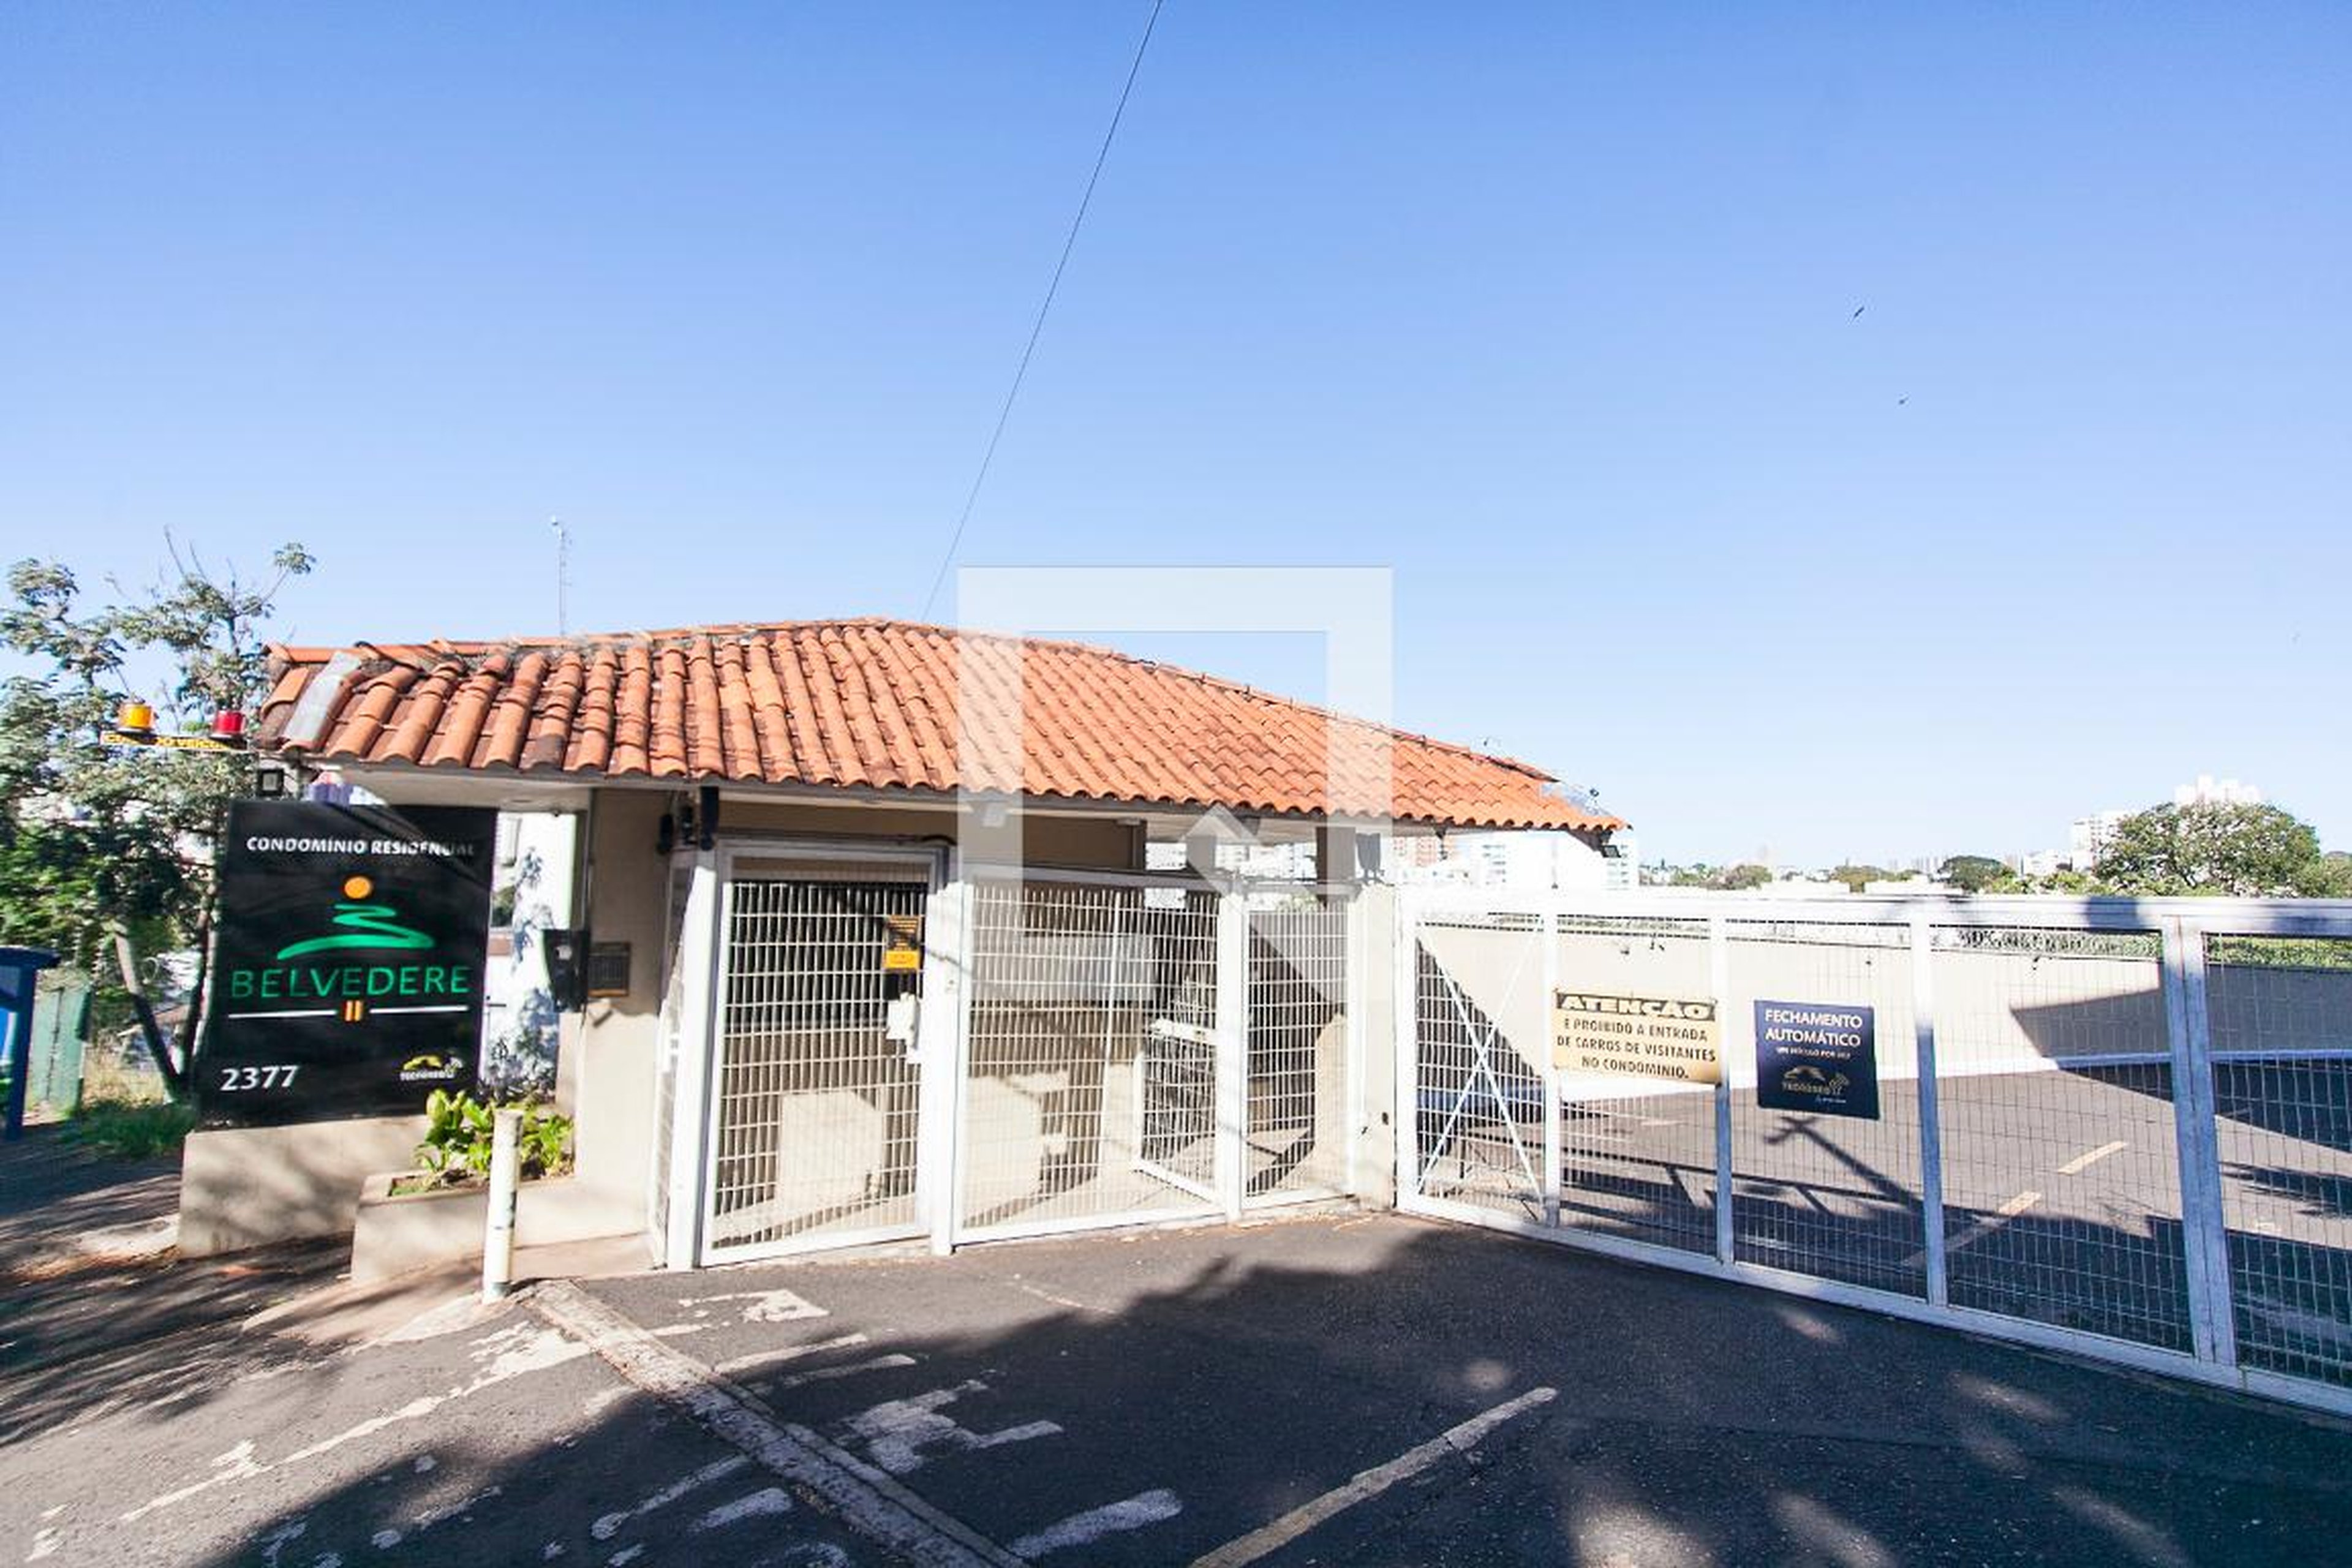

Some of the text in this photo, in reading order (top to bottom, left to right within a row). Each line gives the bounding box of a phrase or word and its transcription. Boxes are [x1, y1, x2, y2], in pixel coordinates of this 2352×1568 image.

[246, 835, 366, 855] CONDOMÍNIO
[231, 966, 471, 998] BELVEDERE
[1573, 1017, 1633, 1035] PROIBIDO
[1636, 1023, 1645, 1036] A
[1648, 1024, 1709, 1042] ENTRADA
[1765, 1009, 1863, 1029] FECHAMENTO
[1765, 1027, 1861, 1047] AUTOMÁTICO
[1556, 1035, 1717, 1063] DE CARROS DE VISITANTES
[1581, 1055, 1600, 1069] NO
[220, 1065, 300, 1091] 2377
